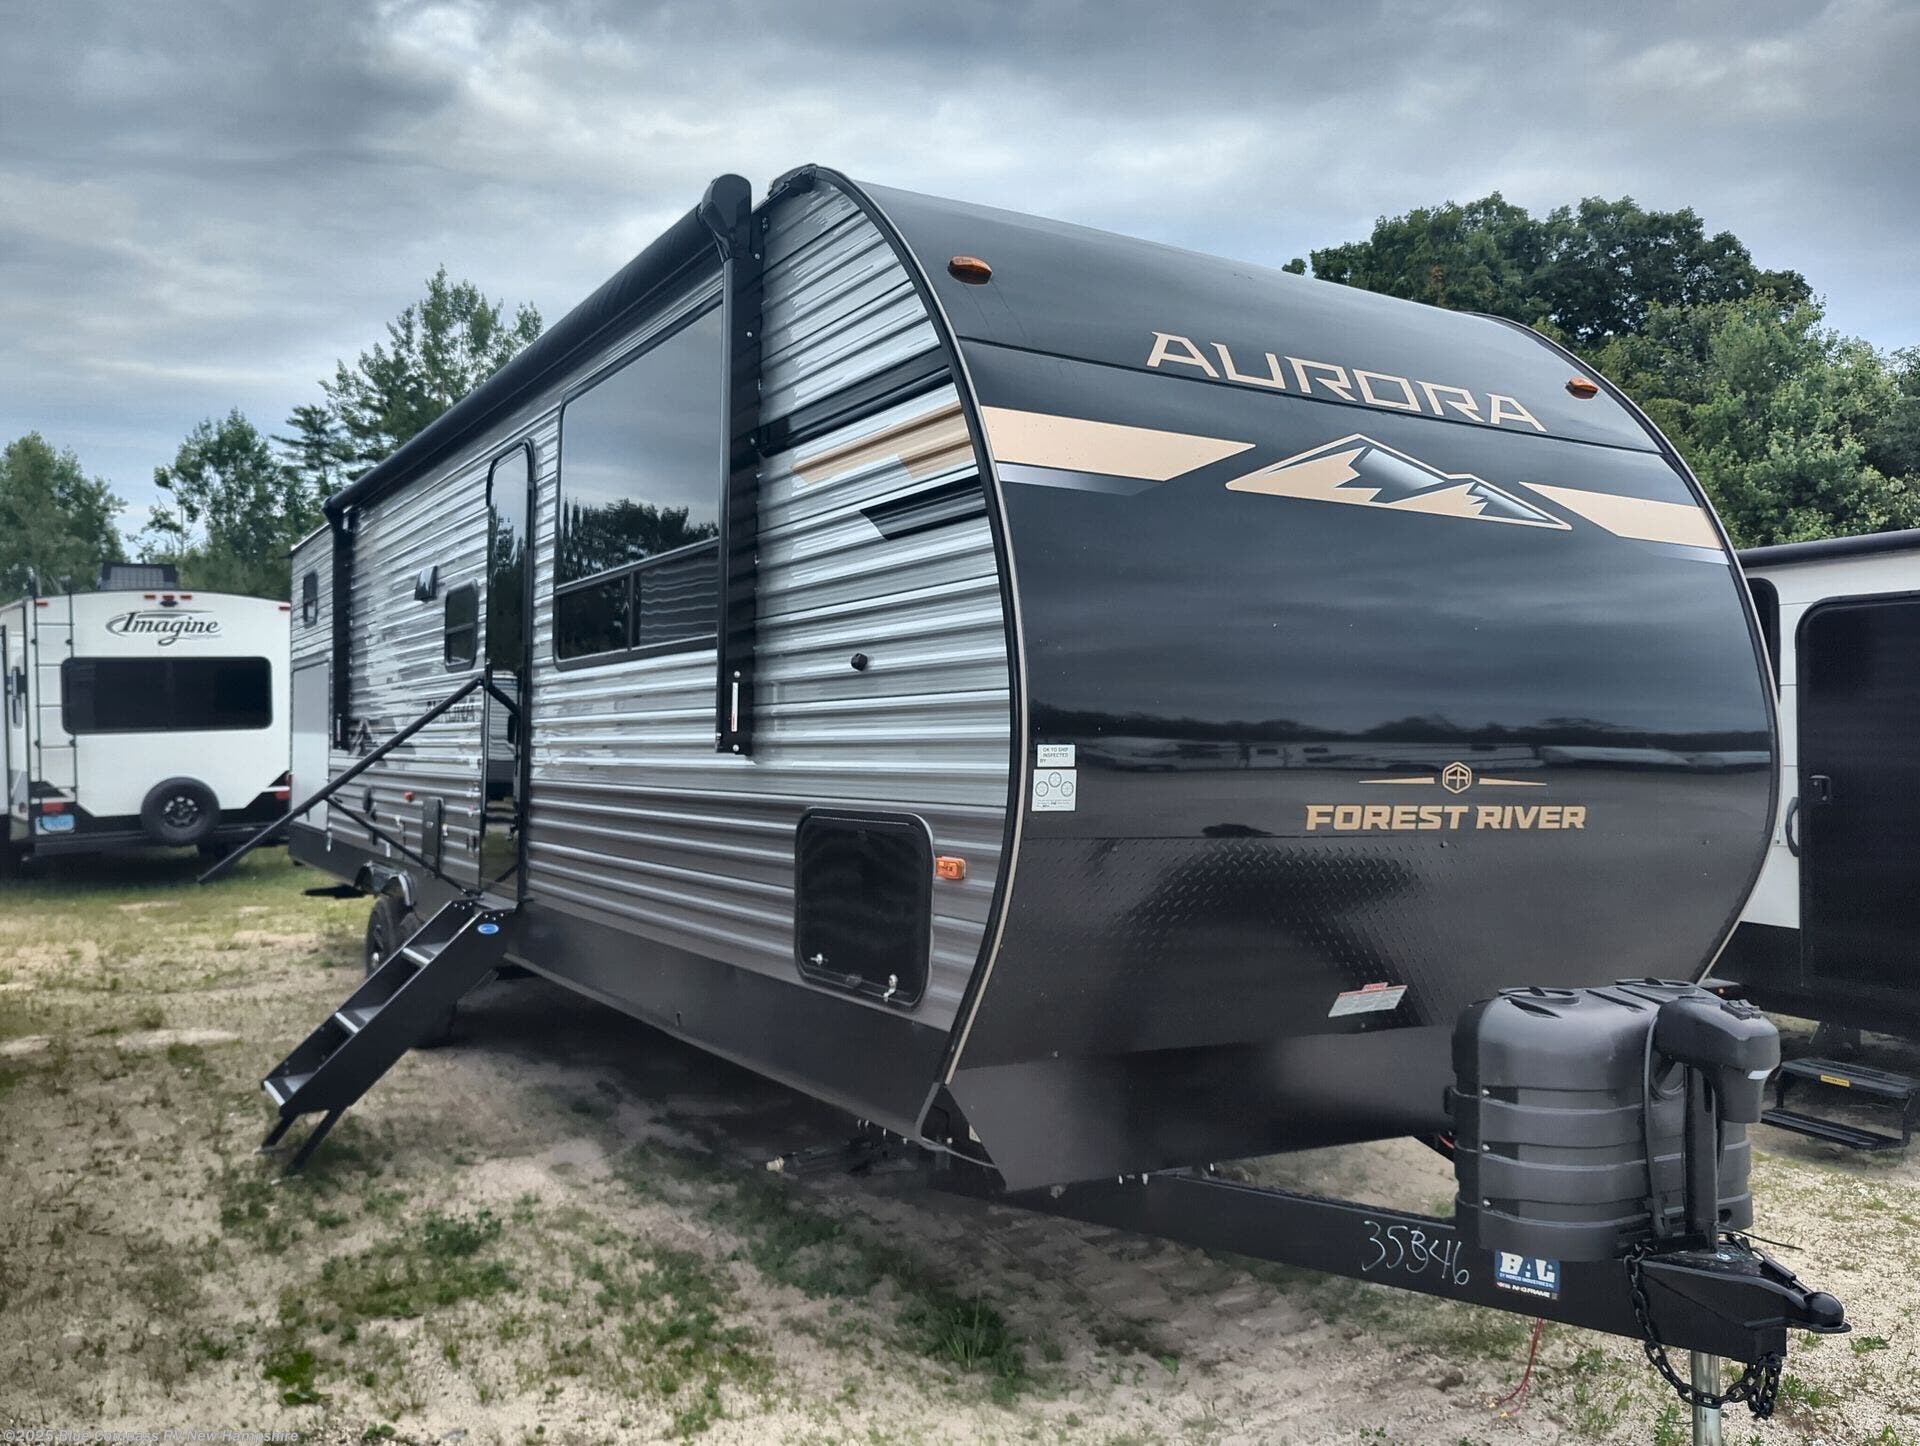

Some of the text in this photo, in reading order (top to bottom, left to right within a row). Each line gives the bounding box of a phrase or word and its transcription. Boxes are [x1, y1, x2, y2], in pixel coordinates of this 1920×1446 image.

[1146, 331, 1547, 433] AURORA
[118, 612, 223, 647] Imagine
[1305, 804, 1586, 831] FOREST RIVER
[1499, 1251, 1556, 1283] BAL
